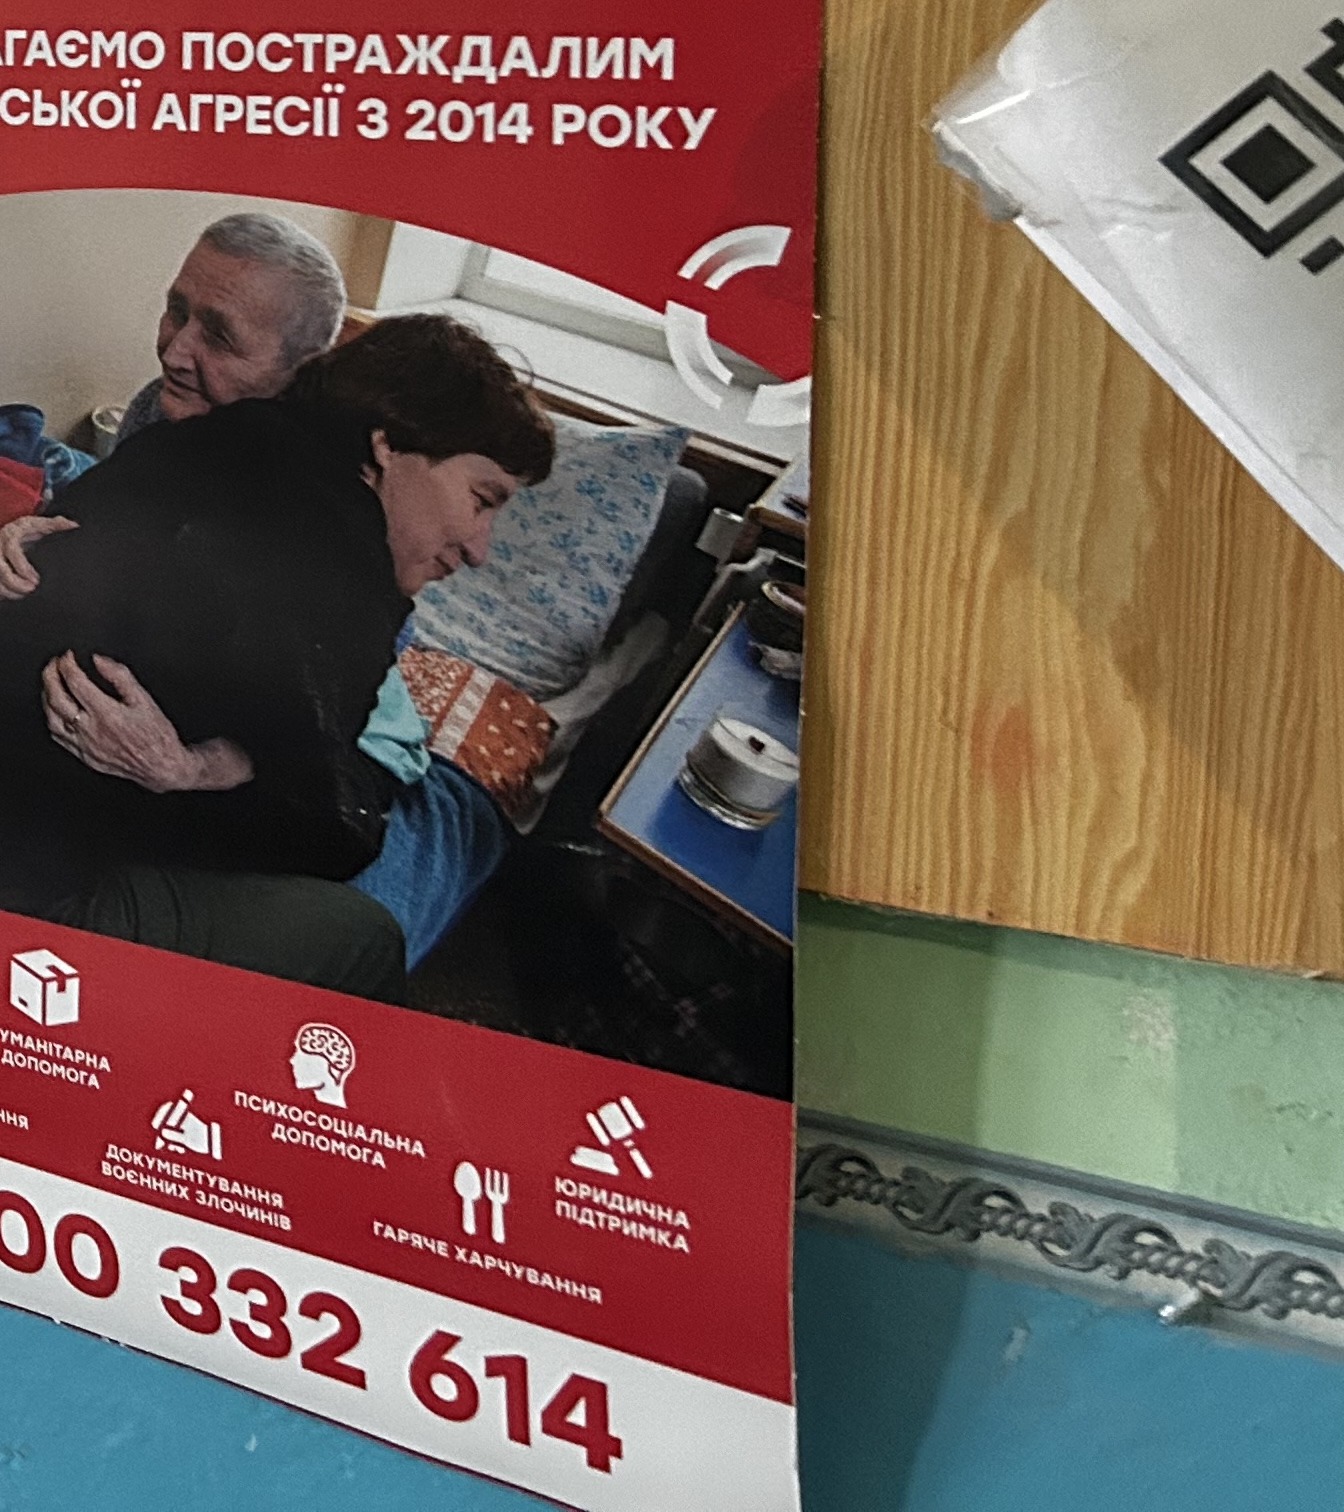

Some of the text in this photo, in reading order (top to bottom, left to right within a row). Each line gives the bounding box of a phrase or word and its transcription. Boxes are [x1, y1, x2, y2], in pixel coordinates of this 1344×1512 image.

[179, 30, 674, 84] ПОСТРАЖДАЛИМ
[151, 82, 347, 139] АГРЕСІЇ
[403, 99, 534, 146] 2014
[550, 104, 717, 152] РОКУ
[0, 1048, 100, 1090] ДОПОМОГА
[234, 1090, 426, 1159] ПСИХОСОЦІАЛЬНА
[270, 1121, 387, 1170] ДОПОМОГА
[100, 1159, 292, 1232] ВОЄННИХ ЗЛОЧИНІВ
[105, 1143, 284, 1210] ДОКУМЕНТУВАННЯ
[554, 1175, 691, 1231] ЮРИДИЧНА
[555, 1199, 690, 1254] ПІДТРИМКА
[372, 1220, 603, 1304] ГАРЯЧЕ ХАРЧУВАННЯ
[157, 1246, 368, 1392] 332
[408, 1329, 623, 1475] 614
